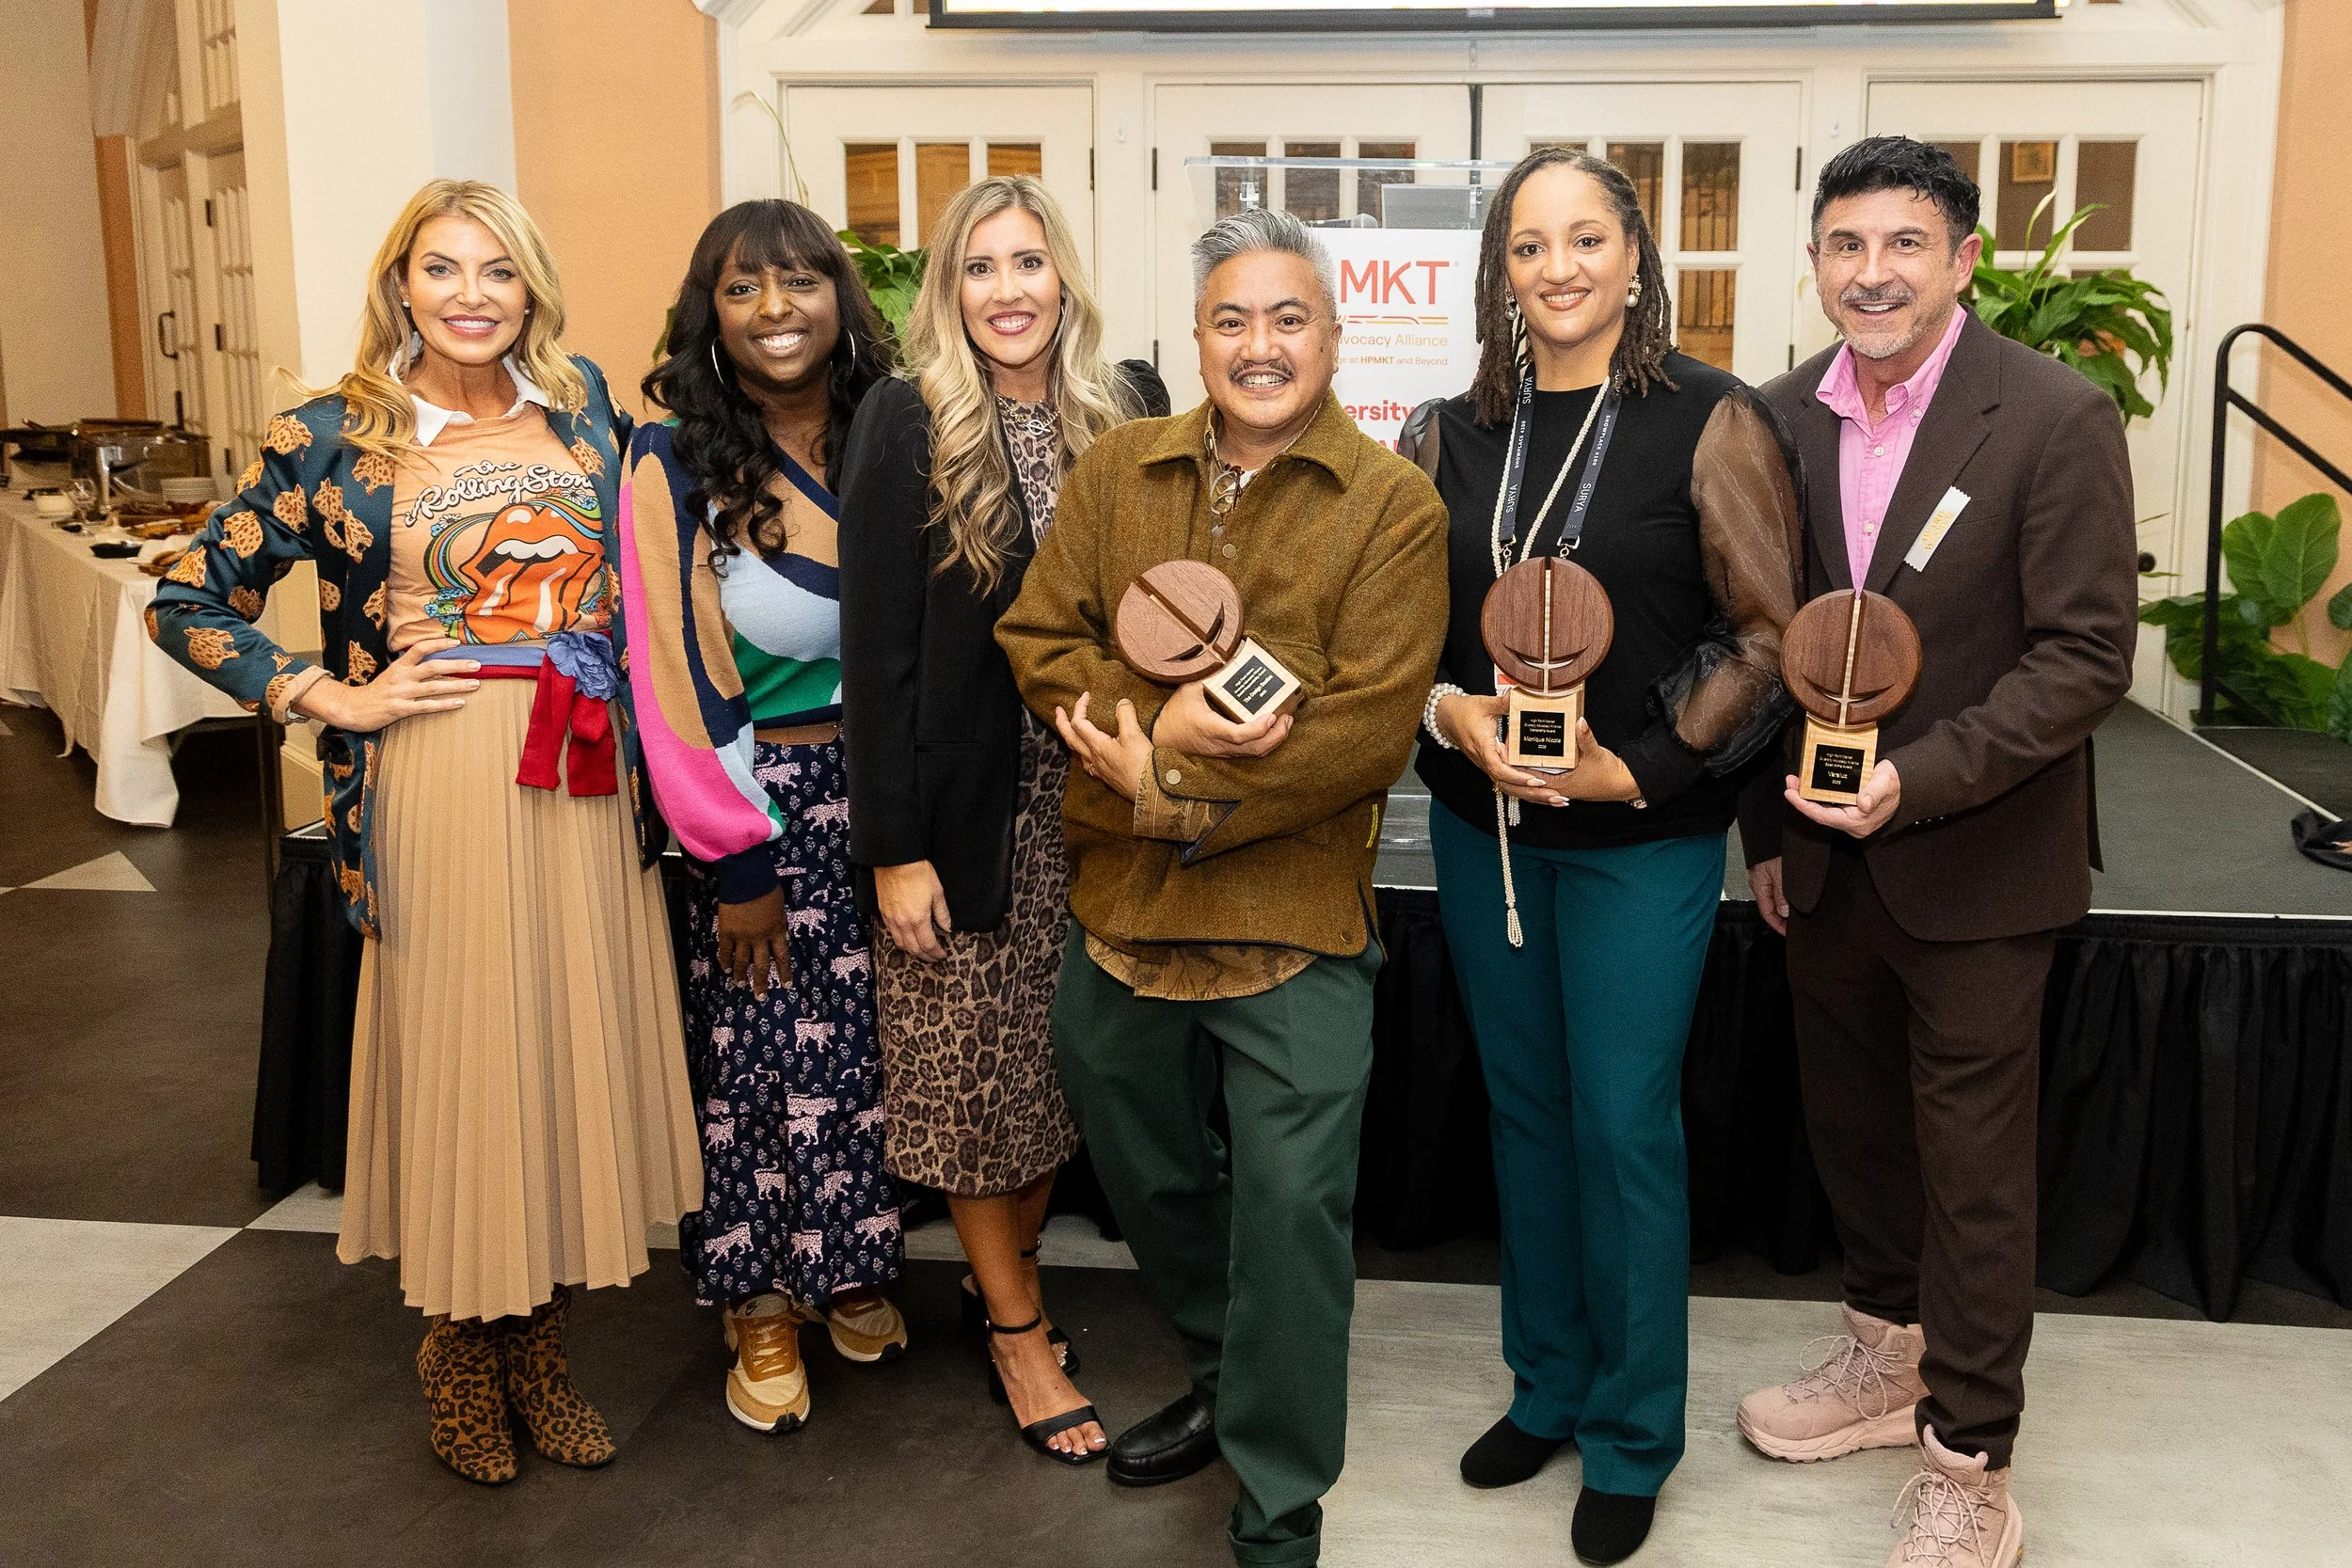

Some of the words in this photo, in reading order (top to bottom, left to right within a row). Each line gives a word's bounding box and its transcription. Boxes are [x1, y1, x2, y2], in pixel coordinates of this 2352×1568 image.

[1341, 260, 1450, 305] MKT
[1395, 333, 1449, 347] Alliance
[1360, 356, 1394, 365] HPMKT
[1396, 356, 1413, 365] and
[1415, 356, 1449, 367] Beyond
[1522, 376, 1534, 404] SURYA
[1343, 400, 1416, 420] ersity
[1597, 415, 1612, 451] SHOWPLACE
[1514, 435, 1524, 468] SHOWPLACE
[405, 475, 523, 528] Rolling
[522, 464, 595, 494] Ston
[1506, 483, 1518, 514] SURYA
[1574, 483, 1592, 513] SURYA
